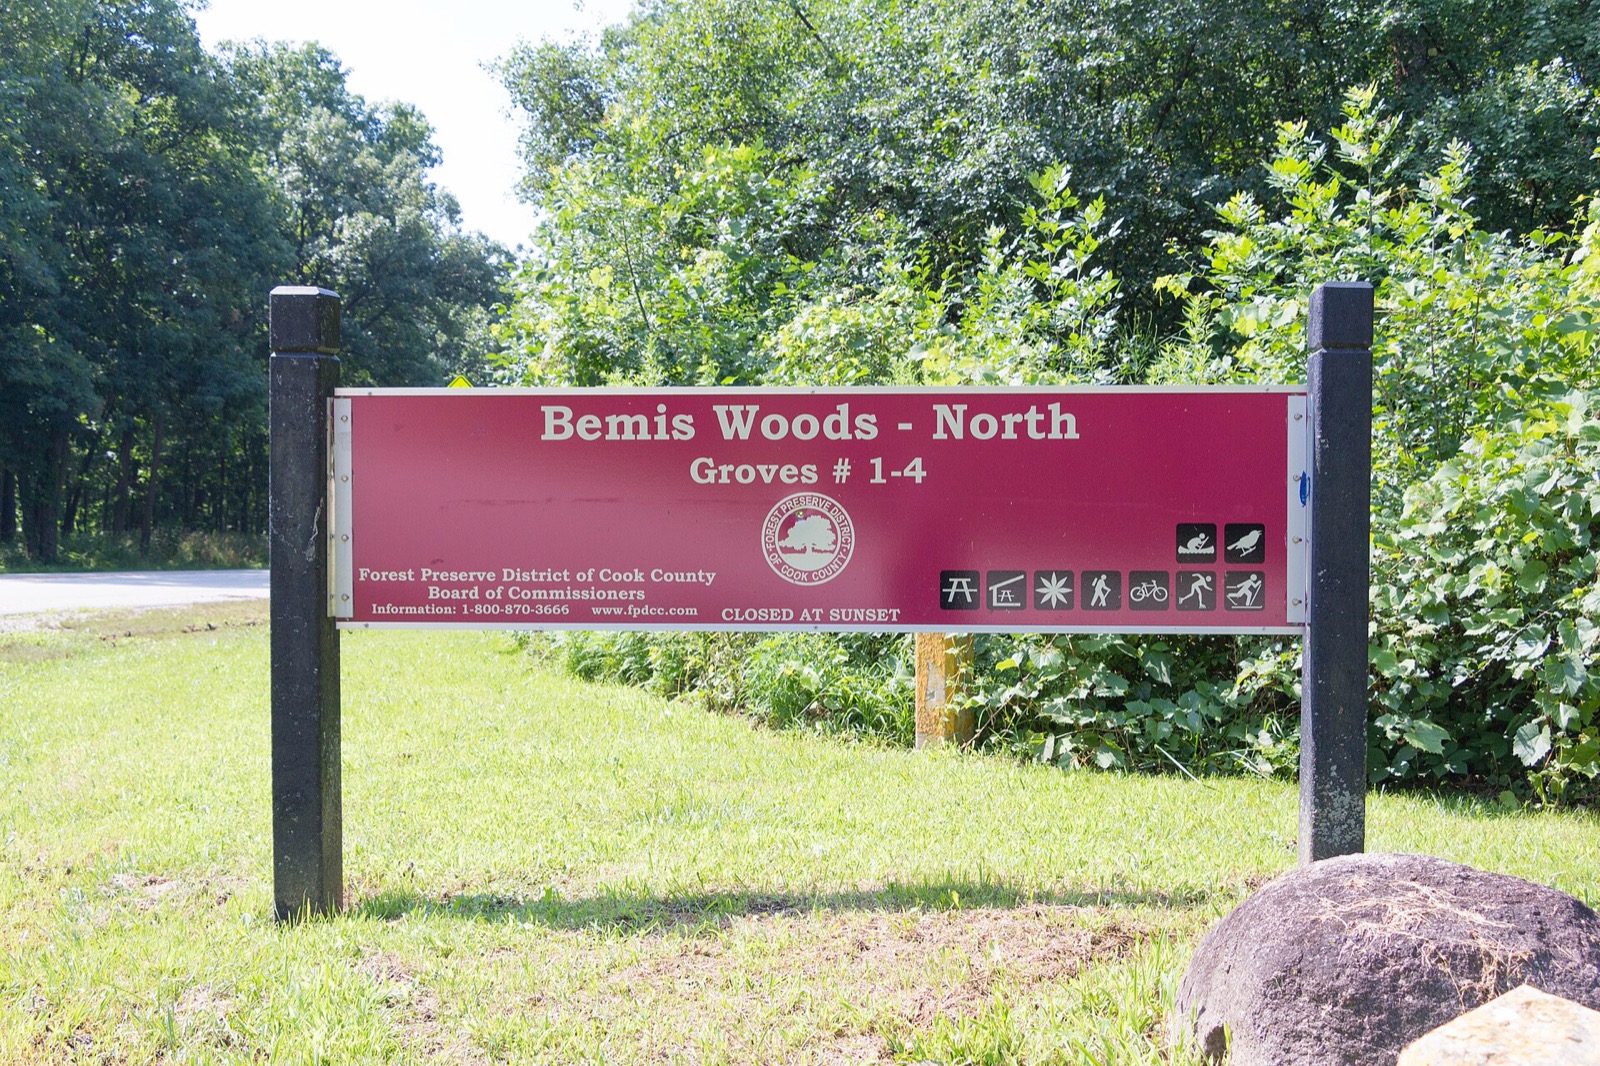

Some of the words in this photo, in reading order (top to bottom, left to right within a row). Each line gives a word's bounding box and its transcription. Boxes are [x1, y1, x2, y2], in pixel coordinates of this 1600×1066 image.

[541, 404, 695, 441] Bemis
[713, 403, 878, 441] Woods
[898, 423, 912, 431] -
[932, 403, 1080, 441] North
[689, 457, 818, 485] Groves
[833, 457, 851, 484] #
[869, 457, 927, 484] 1-4
[766, 510, 781, 550] FOREST
[780, 496, 831, 513] PRESERVE
[830, 506, 851, 549] DISTRICT
[769, 553, 782, 565] OF
[781, 565, 807, 582] COOK
[812, 552, 846, 581] COUNTY
[359, 568, 415, 582] Forest
[421, 568, 495, 582] Preserve
[502, 568, 570, 582] District
[576, 568, 594, 582] of
[598, 568, 645, 583] Cook
[650, 569, 716, 587] County
[428, 586, 479, 600] Board
[485, 586, 503, 600] of
[508, 586, 645, 601] Commissioners
[371, 603, 456, 615] Information:
[463, 604, 570, 615] 1-800-870-3666
[591, 604, 698, 618] www.fpdcc.com
[721, 608, 793, 621] CLOSED
[799, 608, 824, 621] AT
[829, 608, 900, 622] SUNSET
